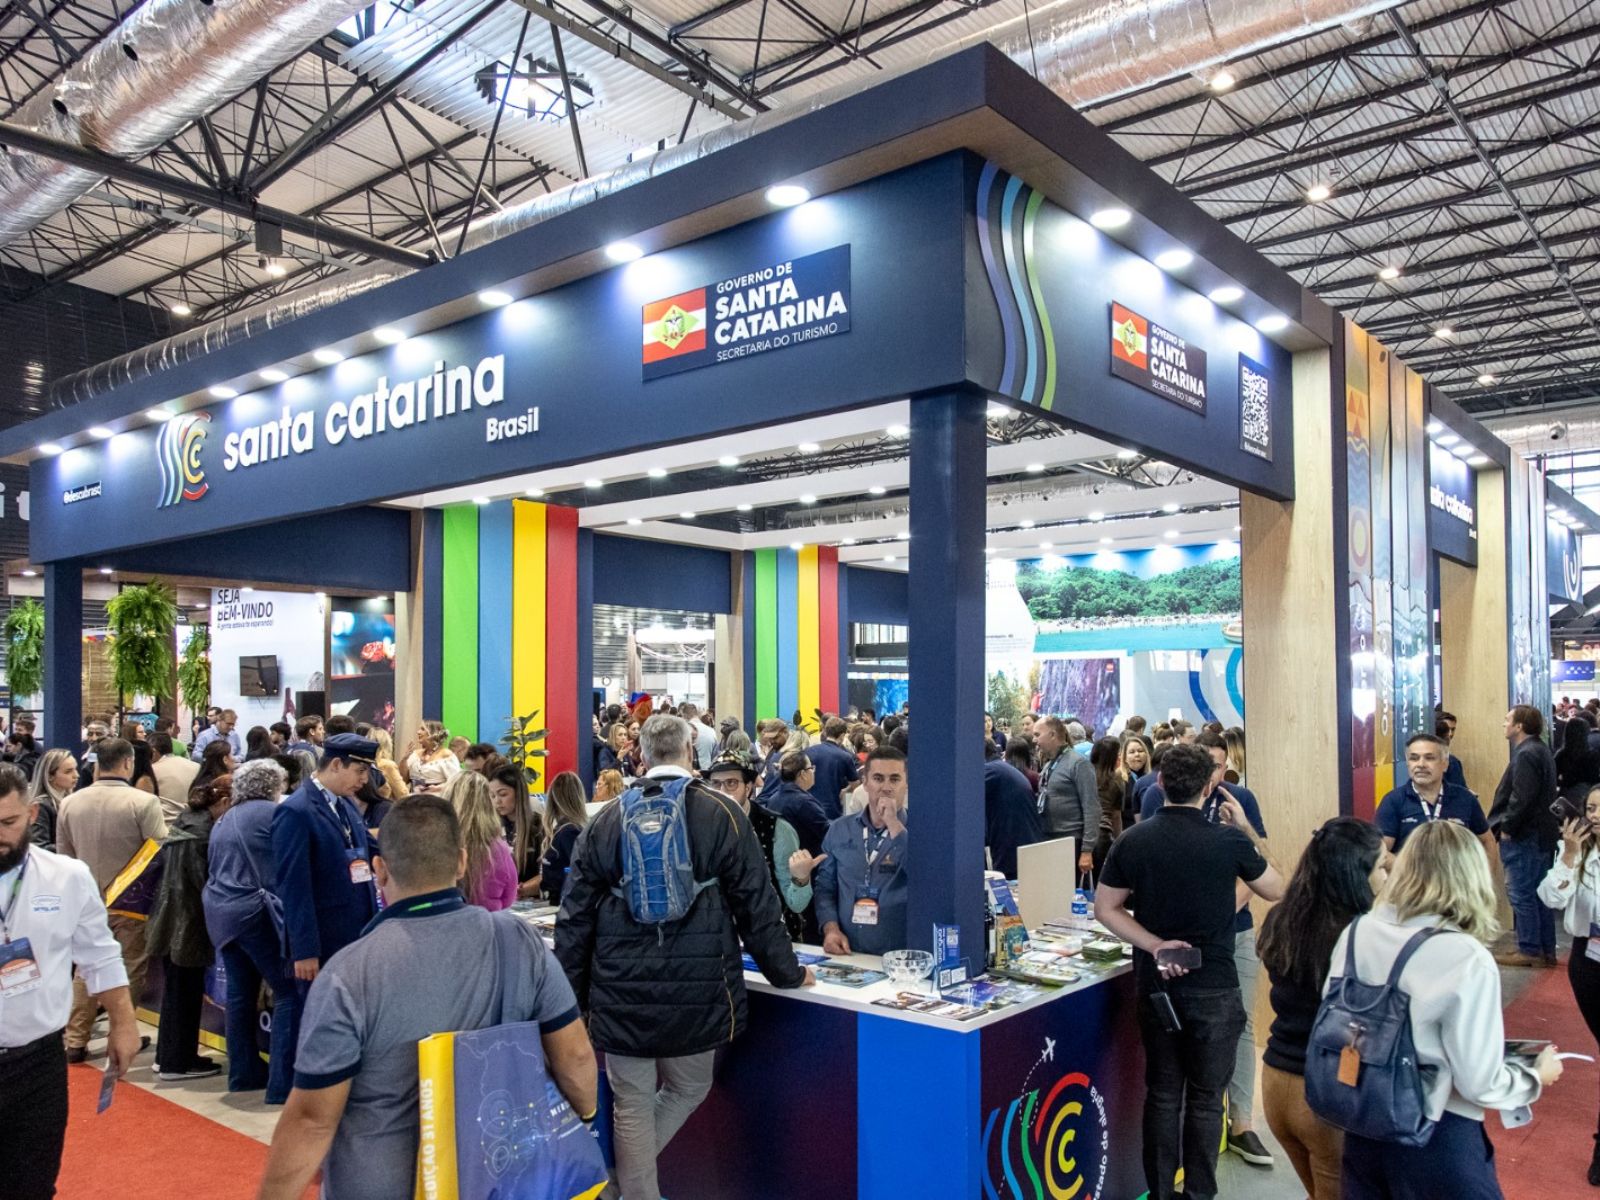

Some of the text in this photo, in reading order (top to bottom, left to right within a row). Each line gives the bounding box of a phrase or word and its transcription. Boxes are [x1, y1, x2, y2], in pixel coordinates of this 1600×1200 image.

[717, 261, 793, 294] GOVERNO DE
[715, 277, 799, 321] SANTA
[714, 291, 848, 345] CATARINA
[716, 322, 838, 362] SECRETARIA DO TURISMO
[1150, 337, 1188, 370] SANTA
[1151, 324, 1186, 350] GOVERNO DE
[1150, 356, 1206, 398] CATARINA
[223, 353, 505, 472] santa catarina
[486, 406, 540, 442] Brasil
[217, 589, 241, 605] SEJA
[217, 601, 274, 621] BEM-VINDO
[420, 1078, 434, 1121] ANOS
[1090, 1085, 1107, 1128] alegria
[422, 1124, 435, 1140] 31
[1101, 1130, 1109, 1151] de
